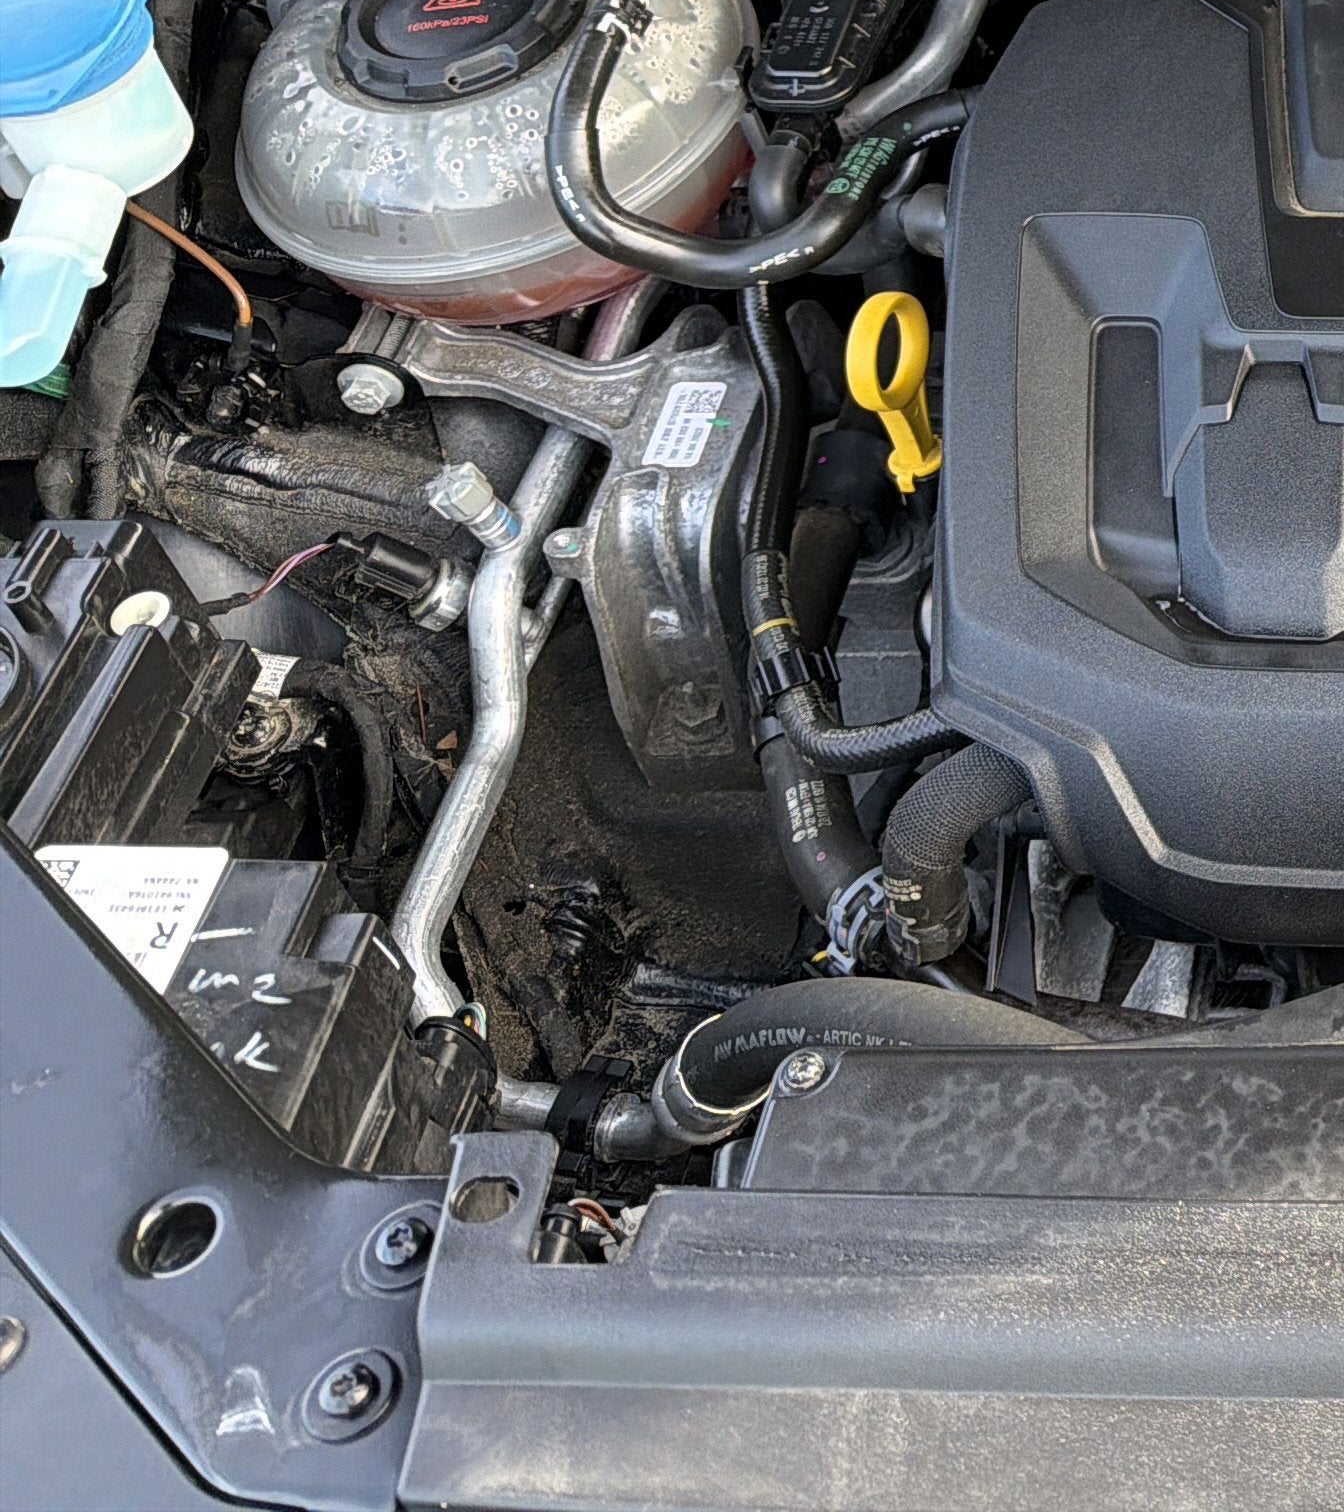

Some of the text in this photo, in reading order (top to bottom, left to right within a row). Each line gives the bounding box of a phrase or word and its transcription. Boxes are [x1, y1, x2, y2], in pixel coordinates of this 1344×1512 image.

[406, 14, 490, 33] 160kPa/23PSI
[149, 921, 179, 950] R
[733, 1027, 806, 1057] MAFLOW
[822, 1029, 863, 1047] ARTIC
